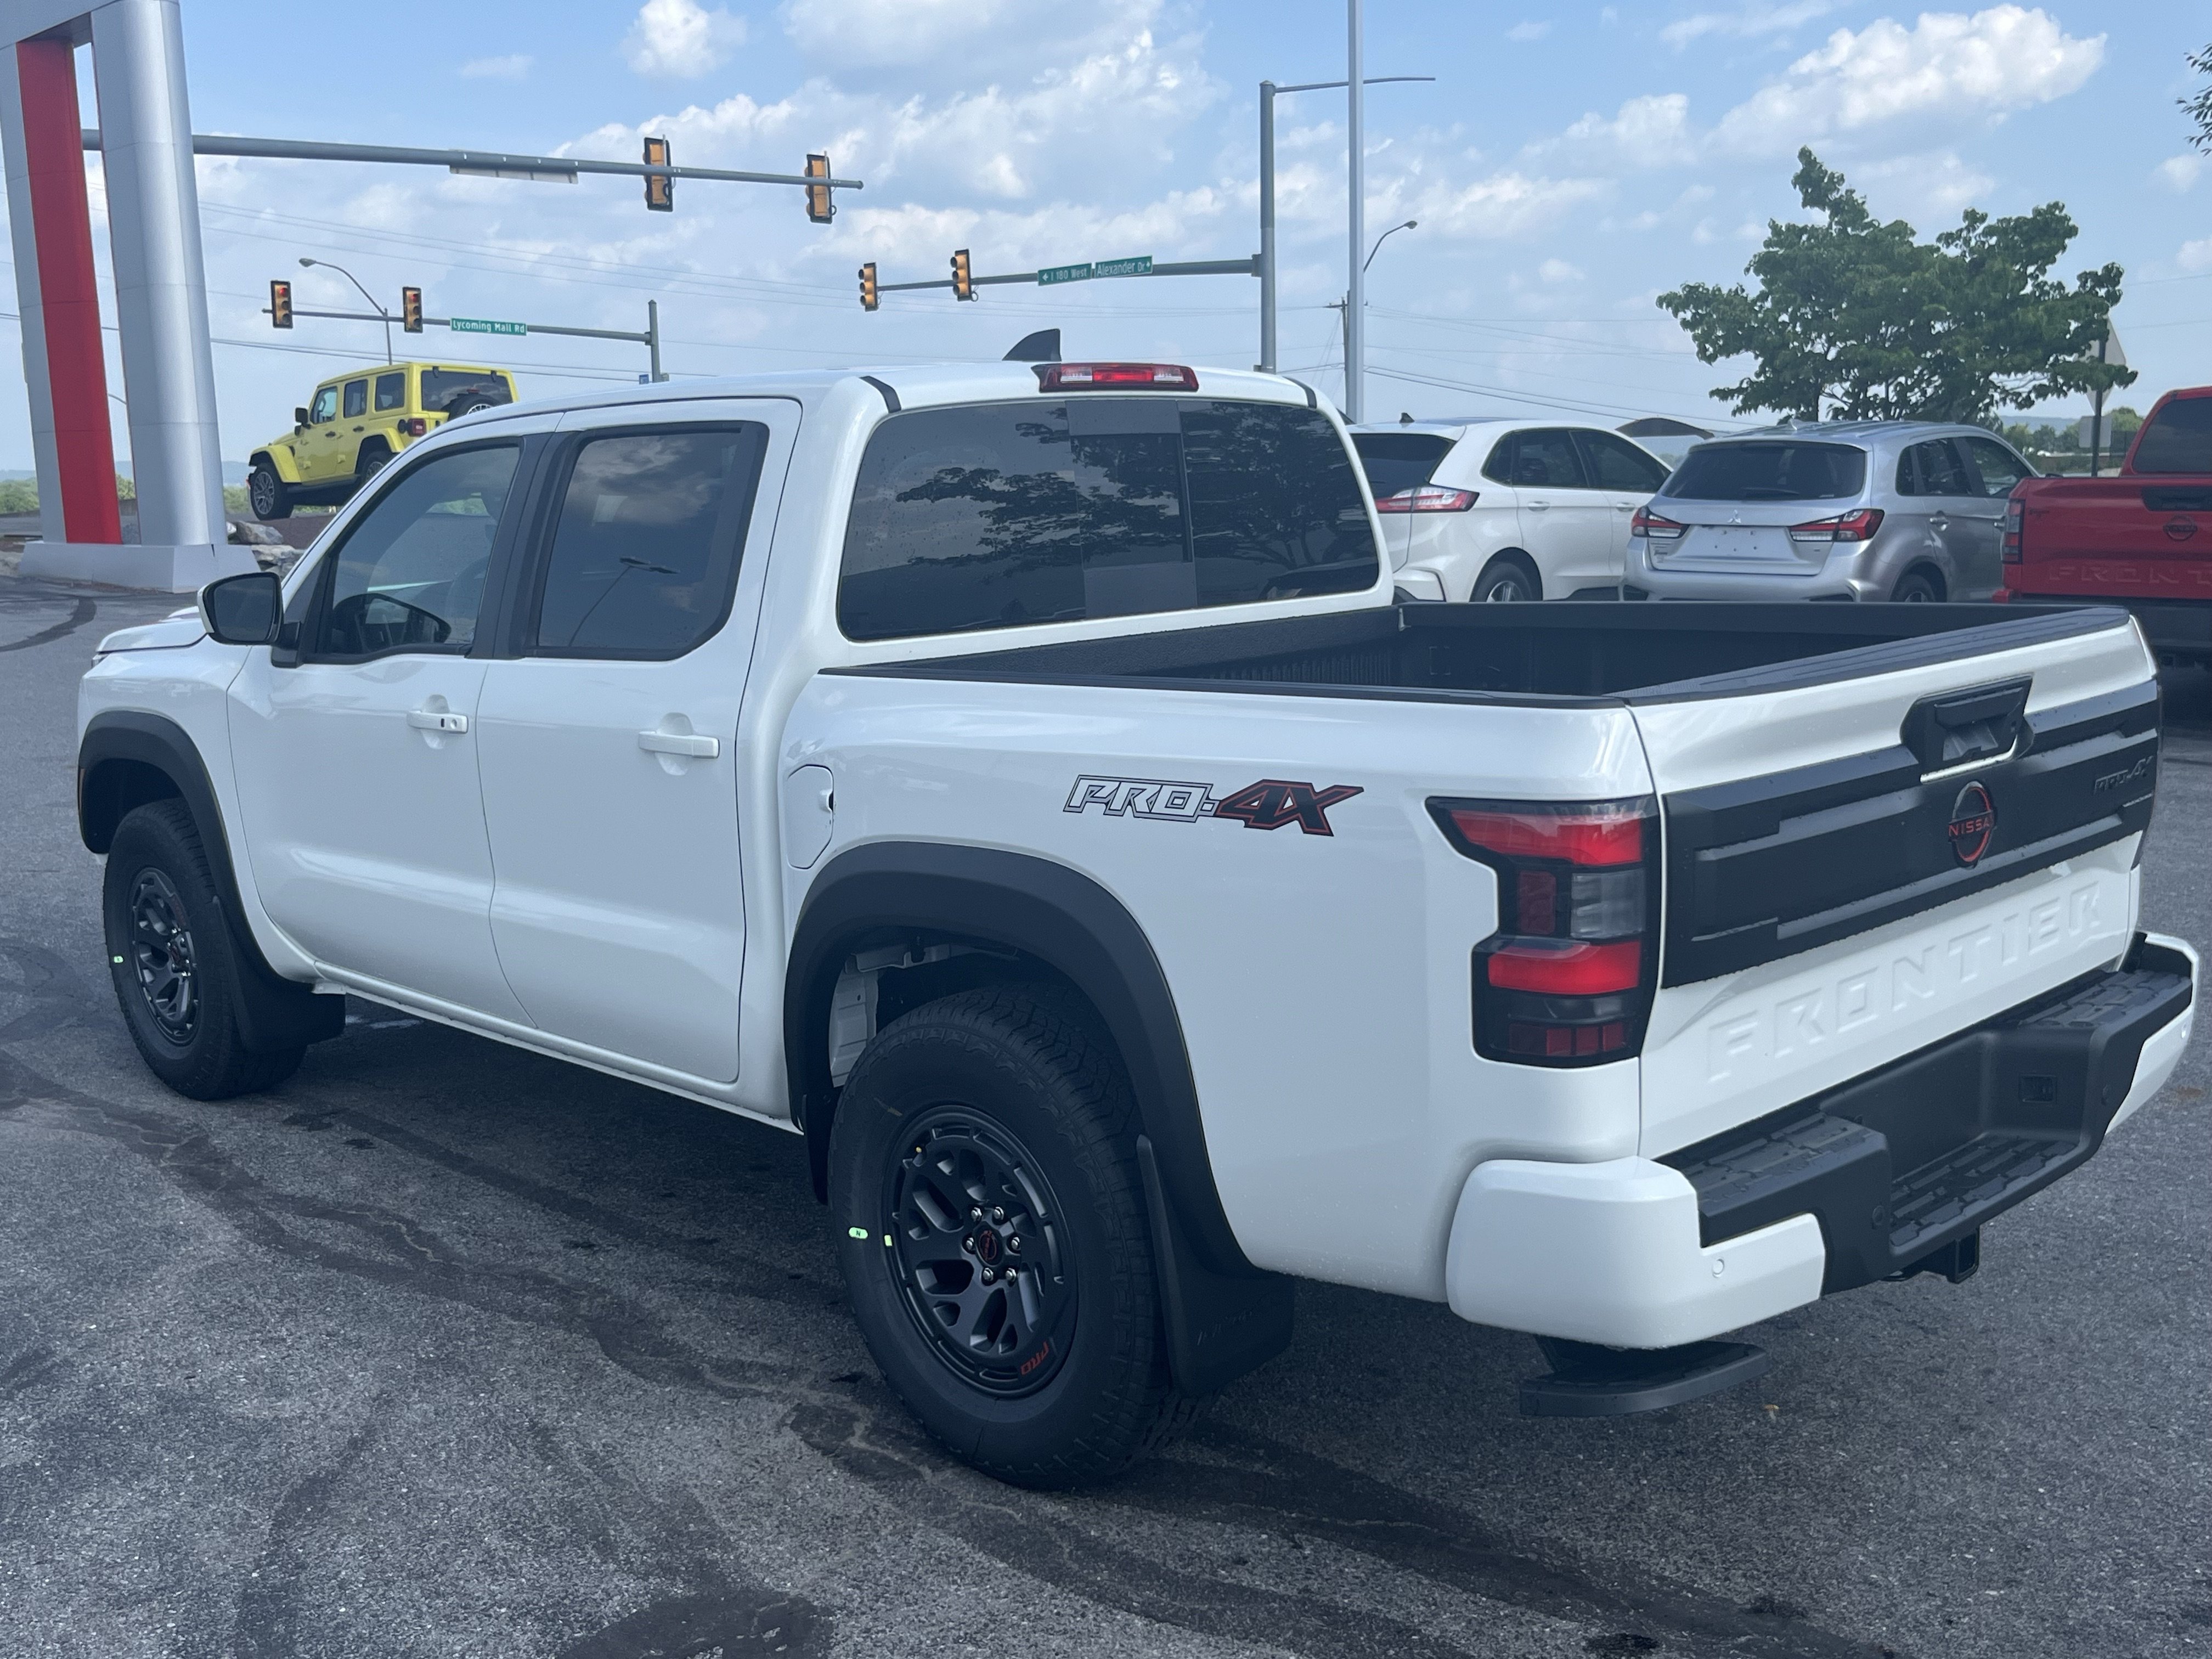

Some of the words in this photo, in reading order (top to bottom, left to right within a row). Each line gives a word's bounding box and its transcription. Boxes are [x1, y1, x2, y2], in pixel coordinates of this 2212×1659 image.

[1057, 270, 1069, 280] 180
[1071, 268, 1087, 279] West
[1097, 262, 1135, 276] Alexander
[1138, 262, 1145, 272] Dr
[453, 320, 492, 332] Lycoming
[495, 323, 512, 332] Mall
[515, 324, 524, 333] Rd
[1063, 774, 1365, 837] PRO-4X
[1949, 817, 1994, 837] NISSA
[1707, 881, 2101, 1083] FRONTIER
[1021, 1341, 1049, 1375] PRO
